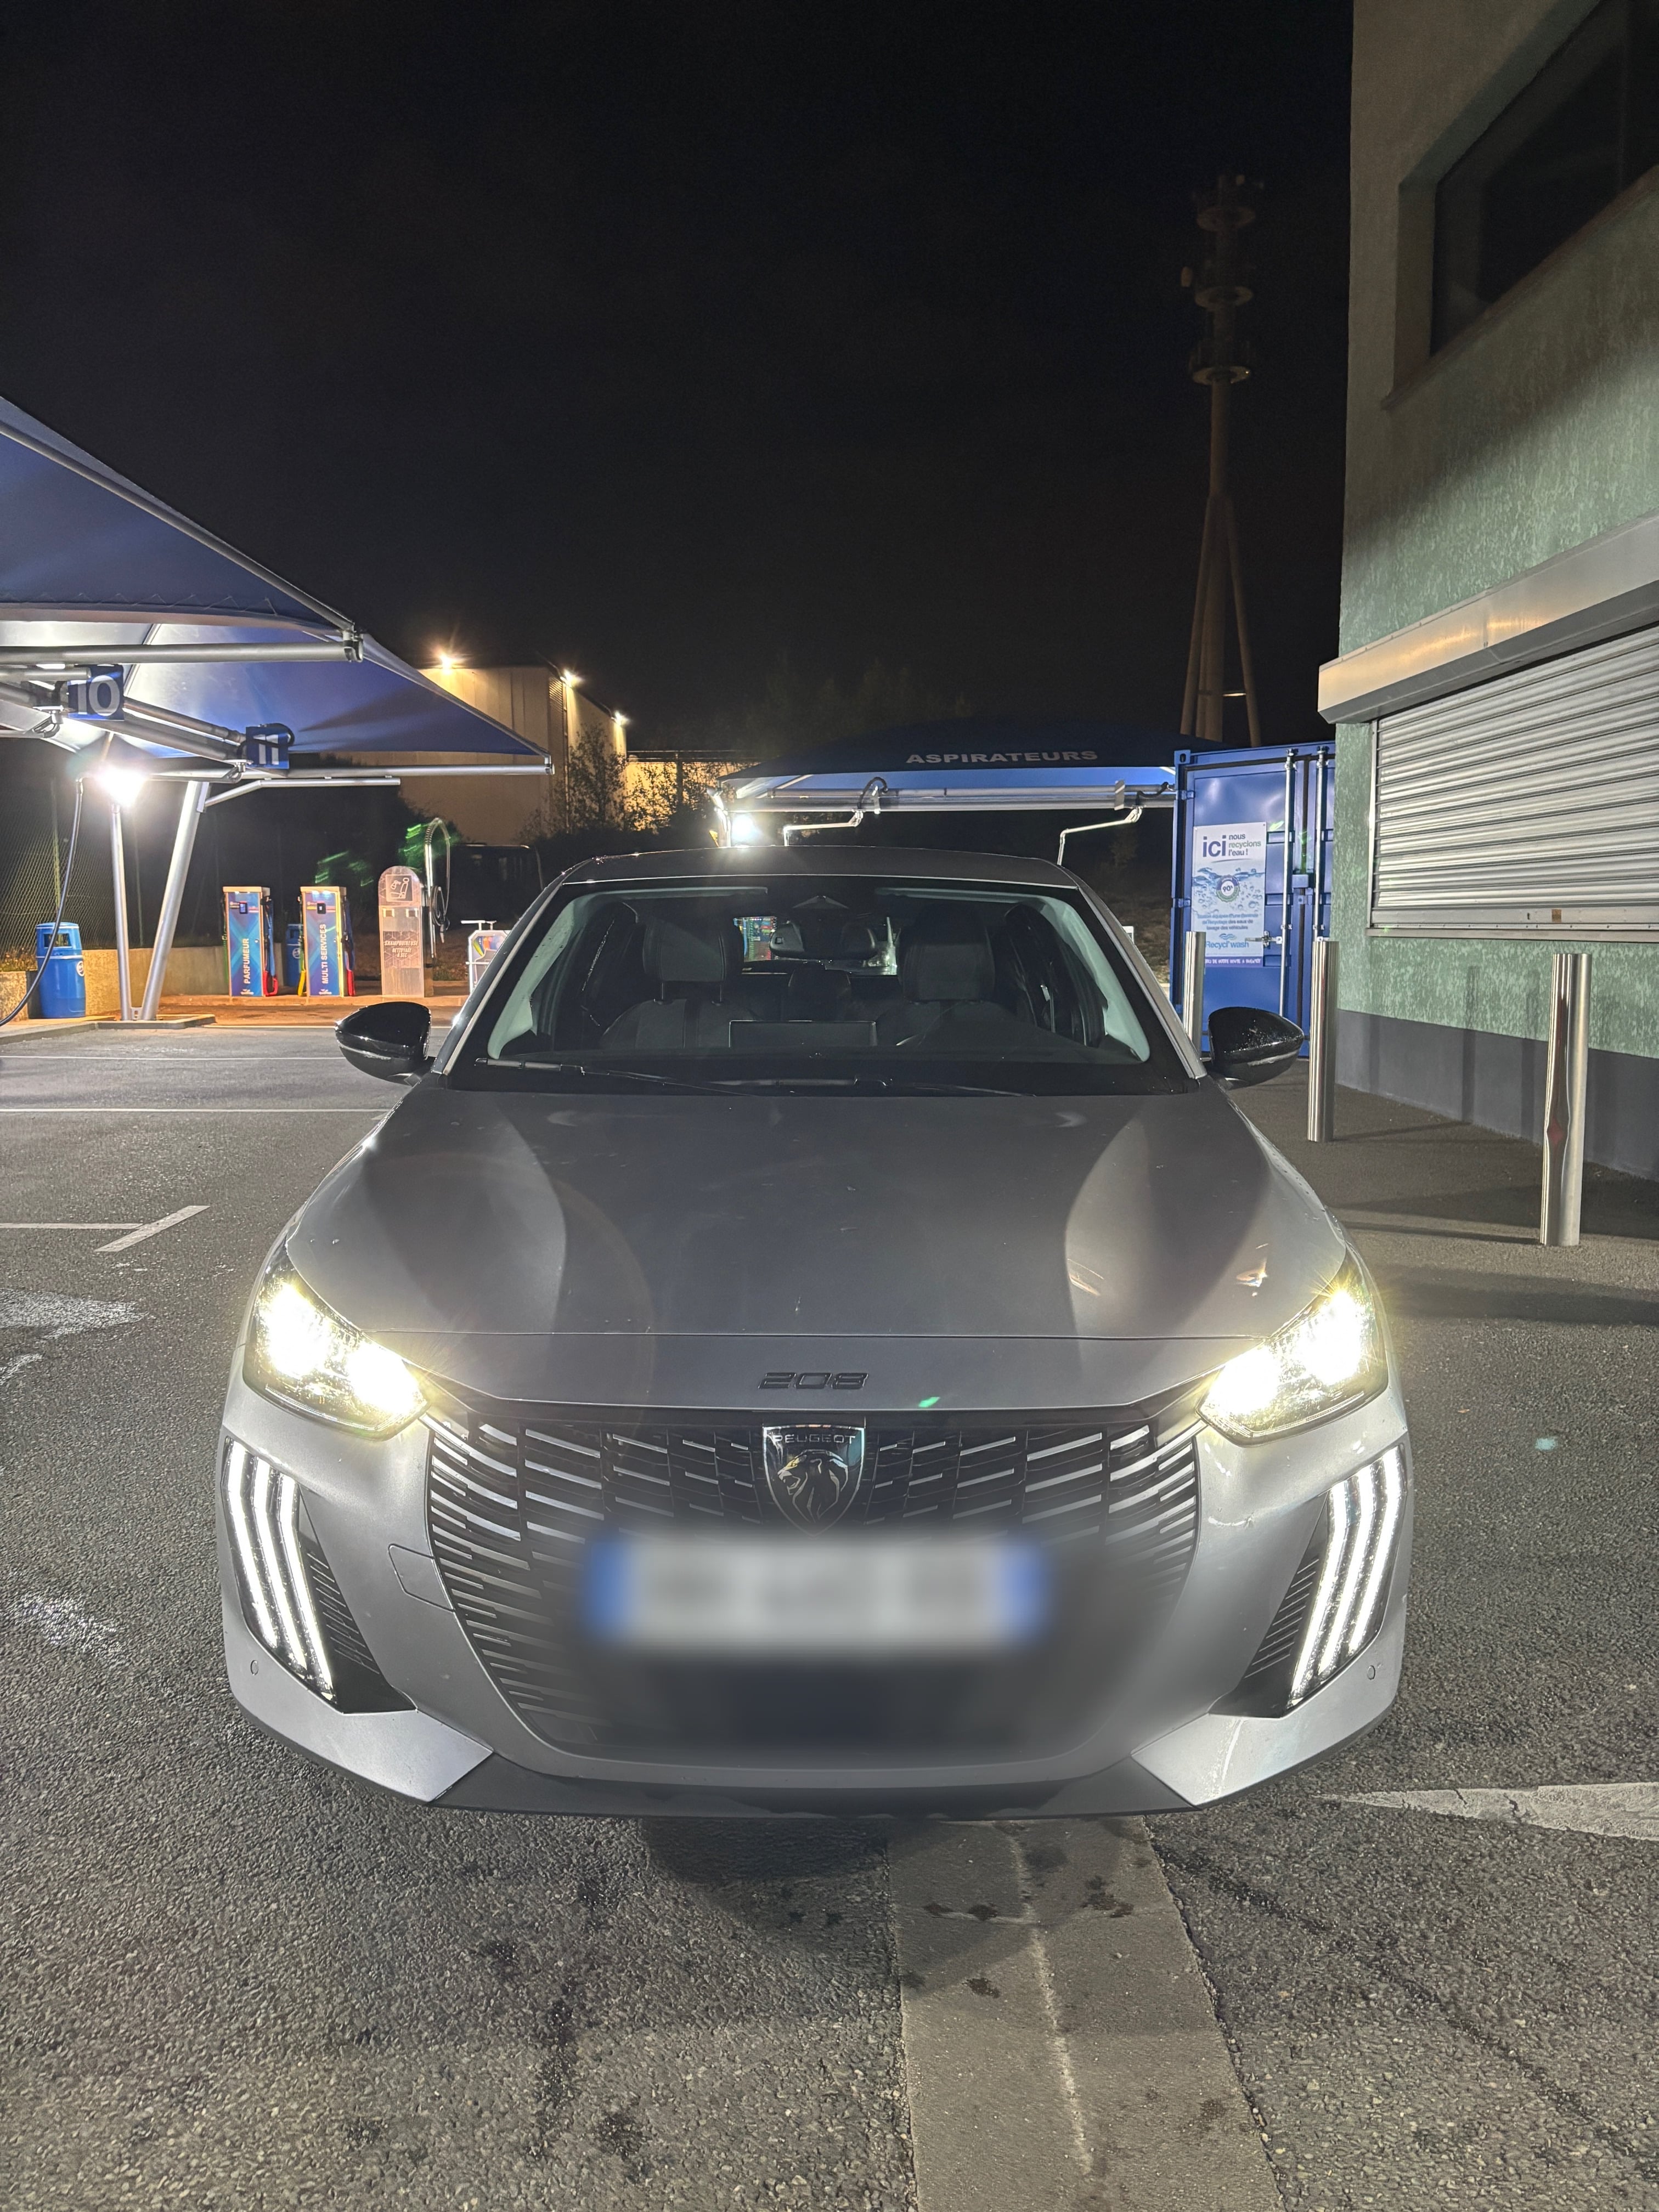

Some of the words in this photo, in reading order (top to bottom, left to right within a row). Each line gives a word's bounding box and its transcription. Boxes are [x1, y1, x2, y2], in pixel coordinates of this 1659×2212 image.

[70, 675, 120, 716] 10
[253, 734, 279, 765] 11
[906, 751, 1098, 763] ASPIRATEURS
[1203, 835, 1226, 857] ici
[1229, 840, 1261, 848] recyclons
[319, 924, 328, 960] SERVICES
[758, 1372, 869, 1389] 208
[772, 1434, 856, 1444] PEUGEOT
